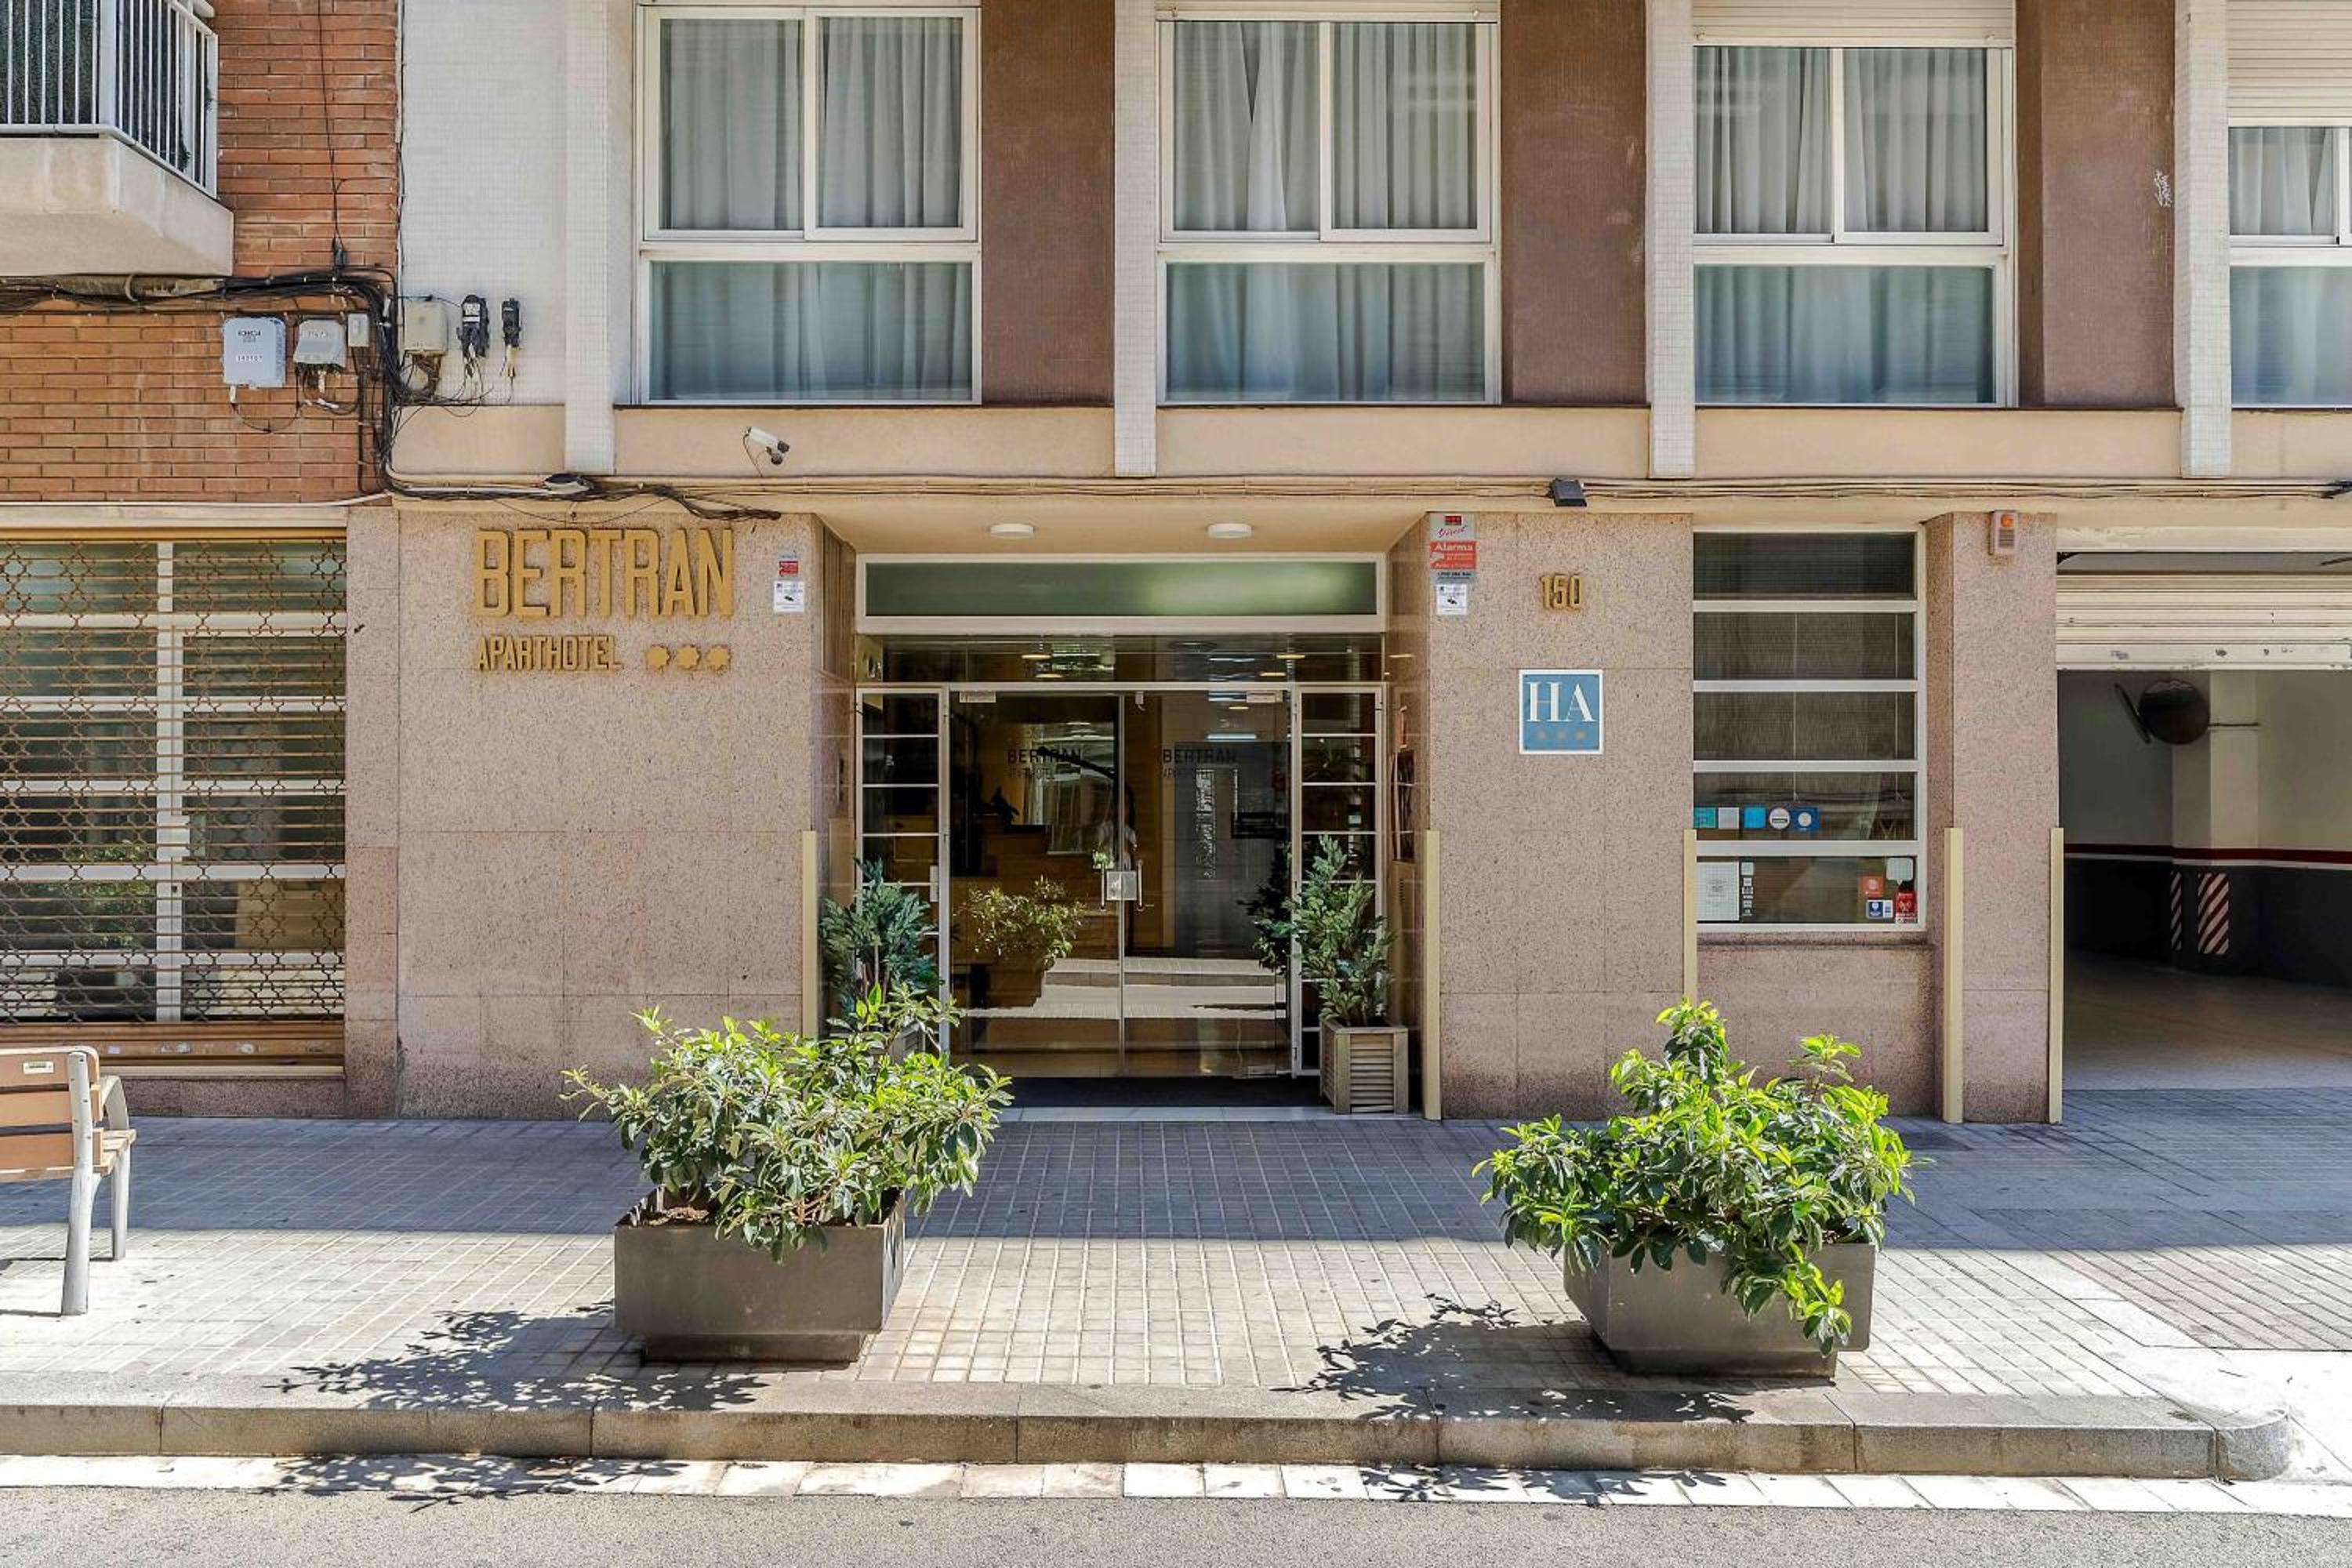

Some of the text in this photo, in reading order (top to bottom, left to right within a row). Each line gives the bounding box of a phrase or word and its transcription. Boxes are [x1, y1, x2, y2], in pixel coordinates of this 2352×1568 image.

[1434, 541, 1474, 551] Alarma
[476, 529, 734, 615] BERTRAN
[1539, 575, 1582, 610] 150
[477, 635, 624, 671] APARTHOTEL
[1526, 681, 1596, 722] HA
[1007, 749, 1081, 764] BERTRAN
[1163, 749, 1237, 764] BERTRAN
